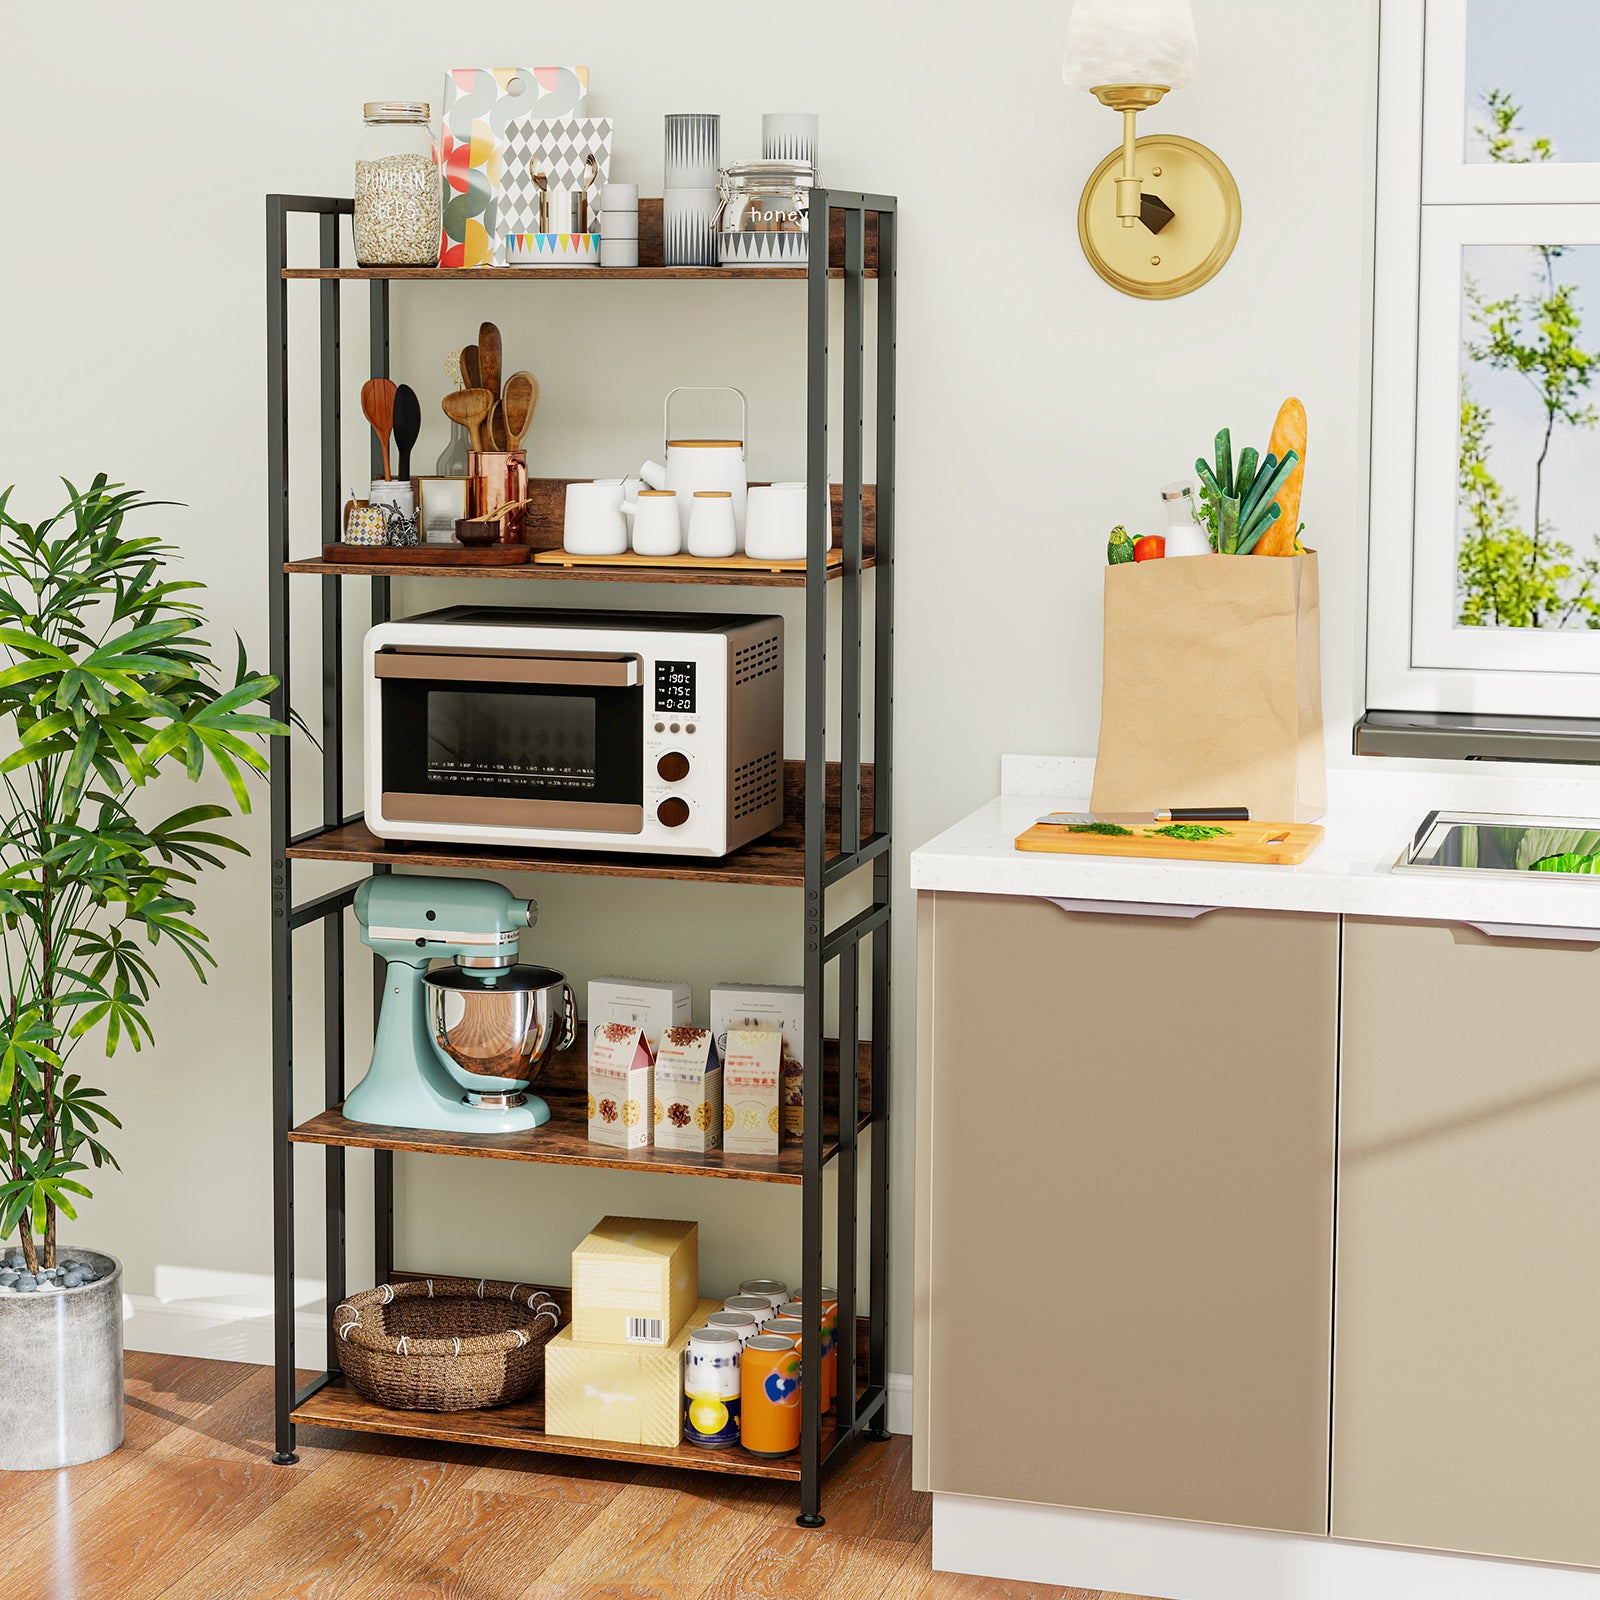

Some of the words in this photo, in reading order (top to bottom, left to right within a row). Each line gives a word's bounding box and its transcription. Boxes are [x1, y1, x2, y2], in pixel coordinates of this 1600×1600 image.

[364, 170, 425, 190] PUMPKIN
[370, 200, 416, 219] SEEDS
[751, 206, 809, 227] honey
[666, 698, 691, 710] 0:20
